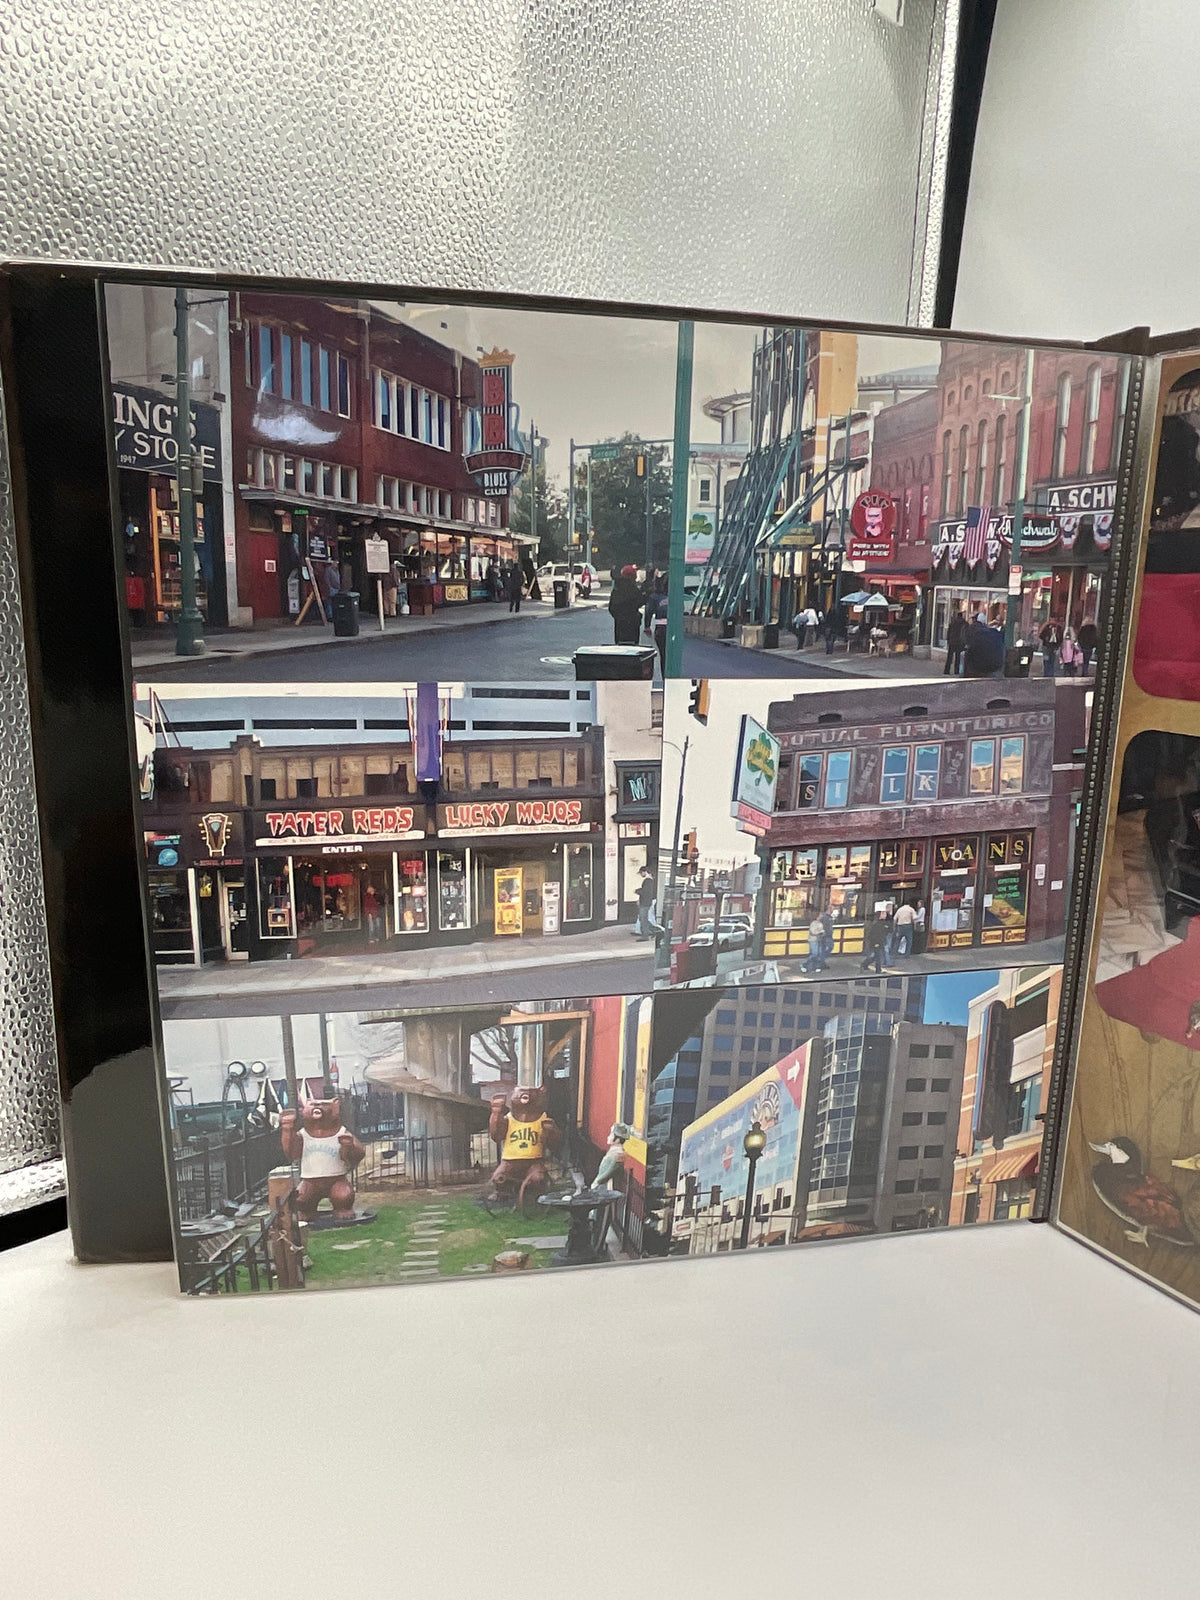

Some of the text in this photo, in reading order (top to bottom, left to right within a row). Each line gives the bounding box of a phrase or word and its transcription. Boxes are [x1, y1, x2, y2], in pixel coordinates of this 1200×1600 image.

[133, 432, 216, 469] STOE
[120, 455, 136, 464] 1947
[484, 473, 507, 487] BLUES
[1021, 519, 1058, 536] chwab
[266, 807, 414, 836] TATER RED'S
[446, 801, 581, 827] LUCKY MOJOS
[322, 845, 364, 853] ENTER
